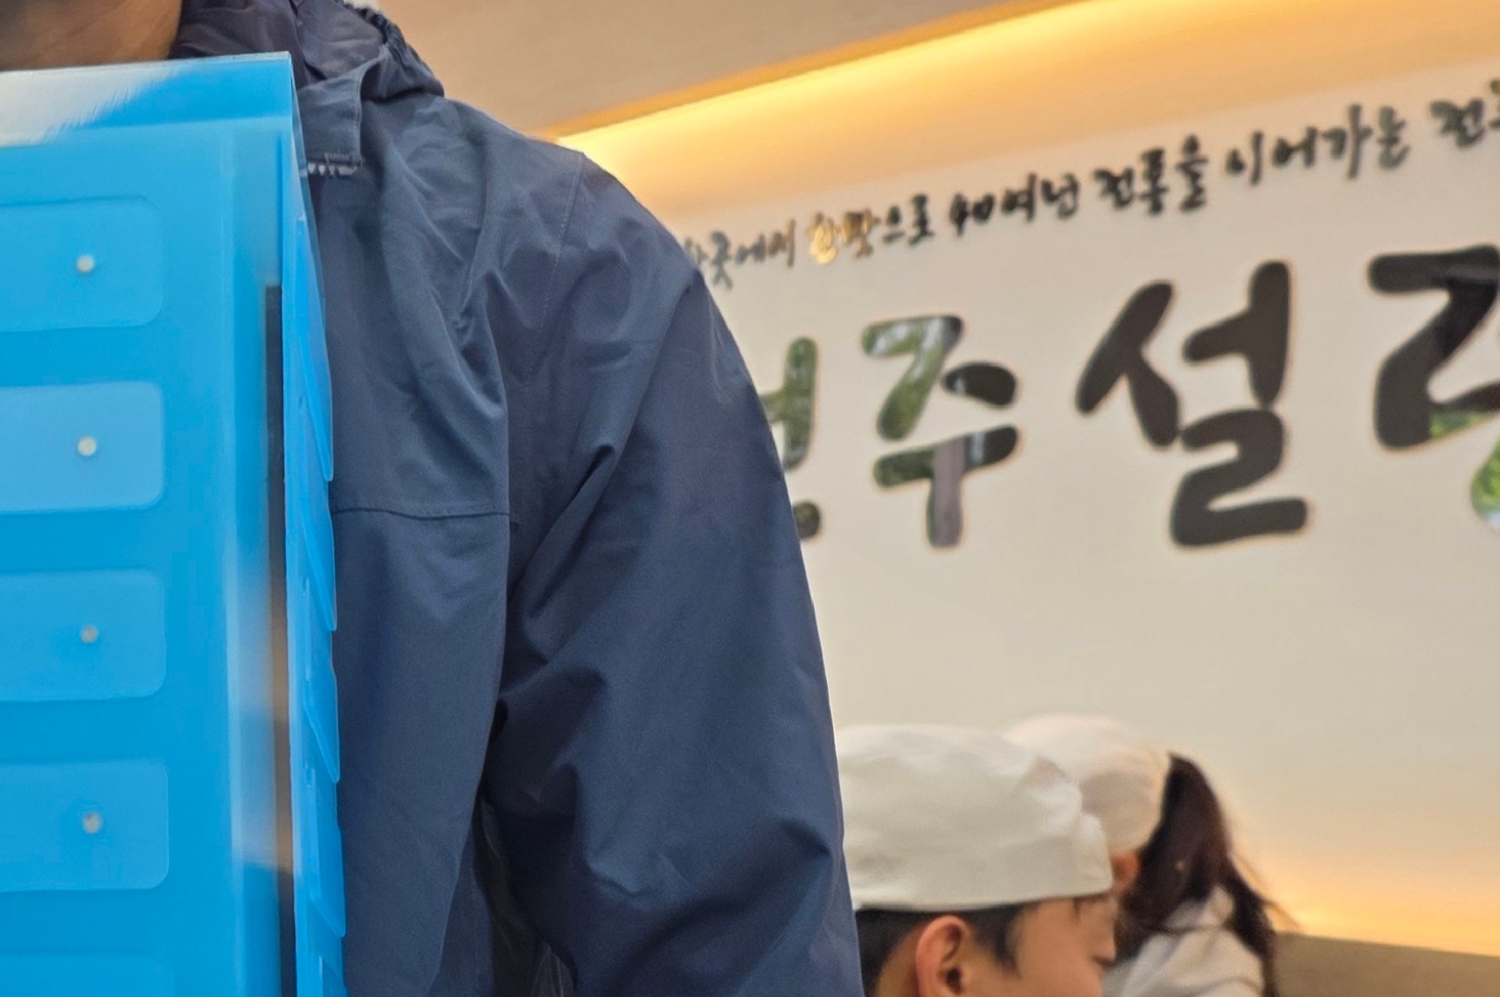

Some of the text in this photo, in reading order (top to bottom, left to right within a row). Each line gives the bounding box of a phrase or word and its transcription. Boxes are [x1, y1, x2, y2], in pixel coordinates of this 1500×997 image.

[1092, 134, 1209, 217] 전통을
[1225, 103, 1410, 188] 이어가는
[1429, 77, 1500, 149] 전
